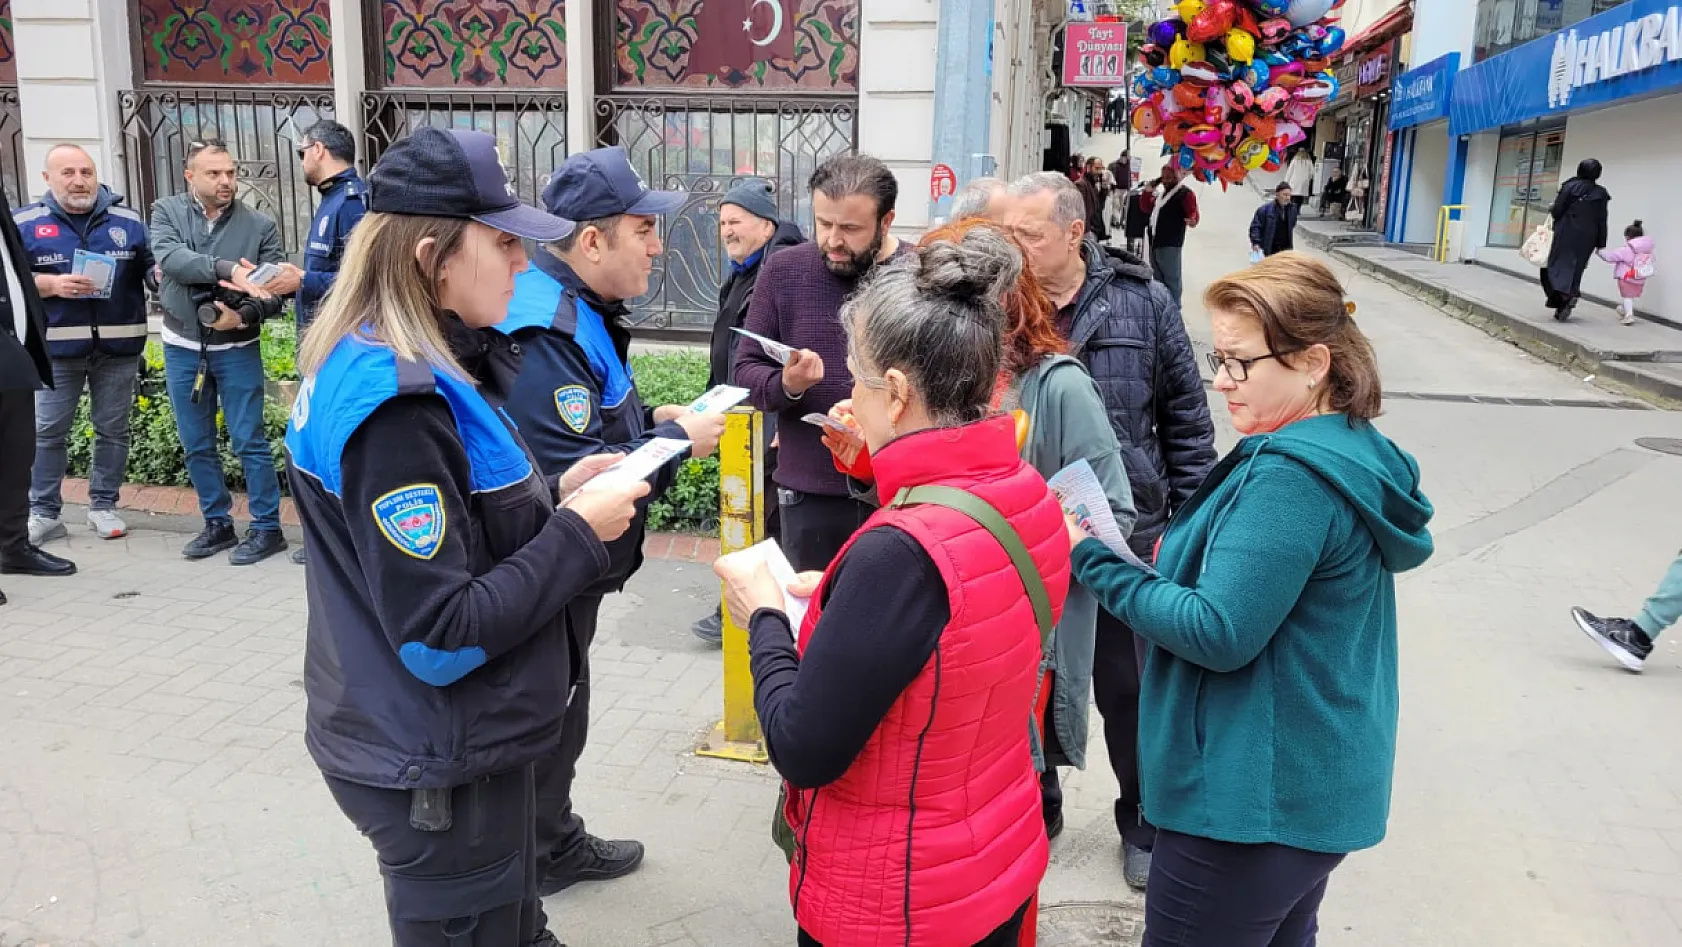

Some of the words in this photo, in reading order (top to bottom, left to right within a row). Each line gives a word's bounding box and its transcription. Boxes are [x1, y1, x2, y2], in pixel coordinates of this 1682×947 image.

[1088, 27, 1114, 40] Tayt
[1077, 40, 1122, 53] Dünyası
[1573, 7, 1682, 88] HALKBA
[395, 499, 424, 511] POLİS
